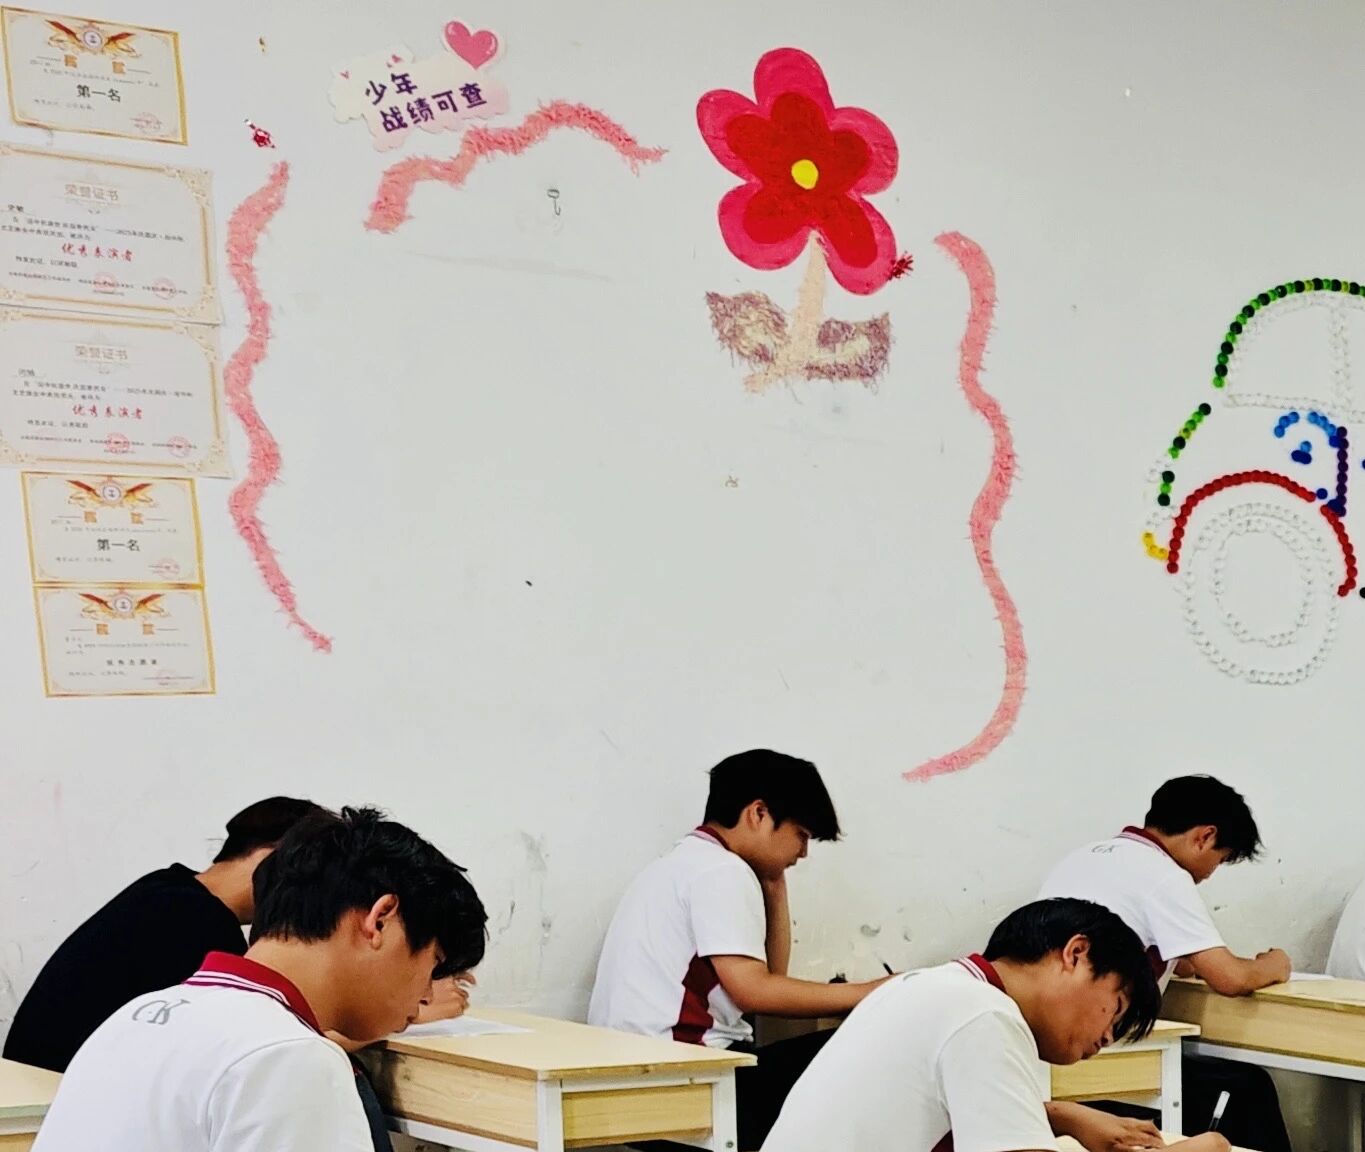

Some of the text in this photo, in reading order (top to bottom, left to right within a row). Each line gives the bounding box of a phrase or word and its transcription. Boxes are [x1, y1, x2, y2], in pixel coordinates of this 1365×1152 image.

[76, 84, 121, 103] 第一名
[365, 72, 418, 106] 少年
[380, 83, 487, 132] 战绩可查
[97, 538, 140, 552] 第一名
